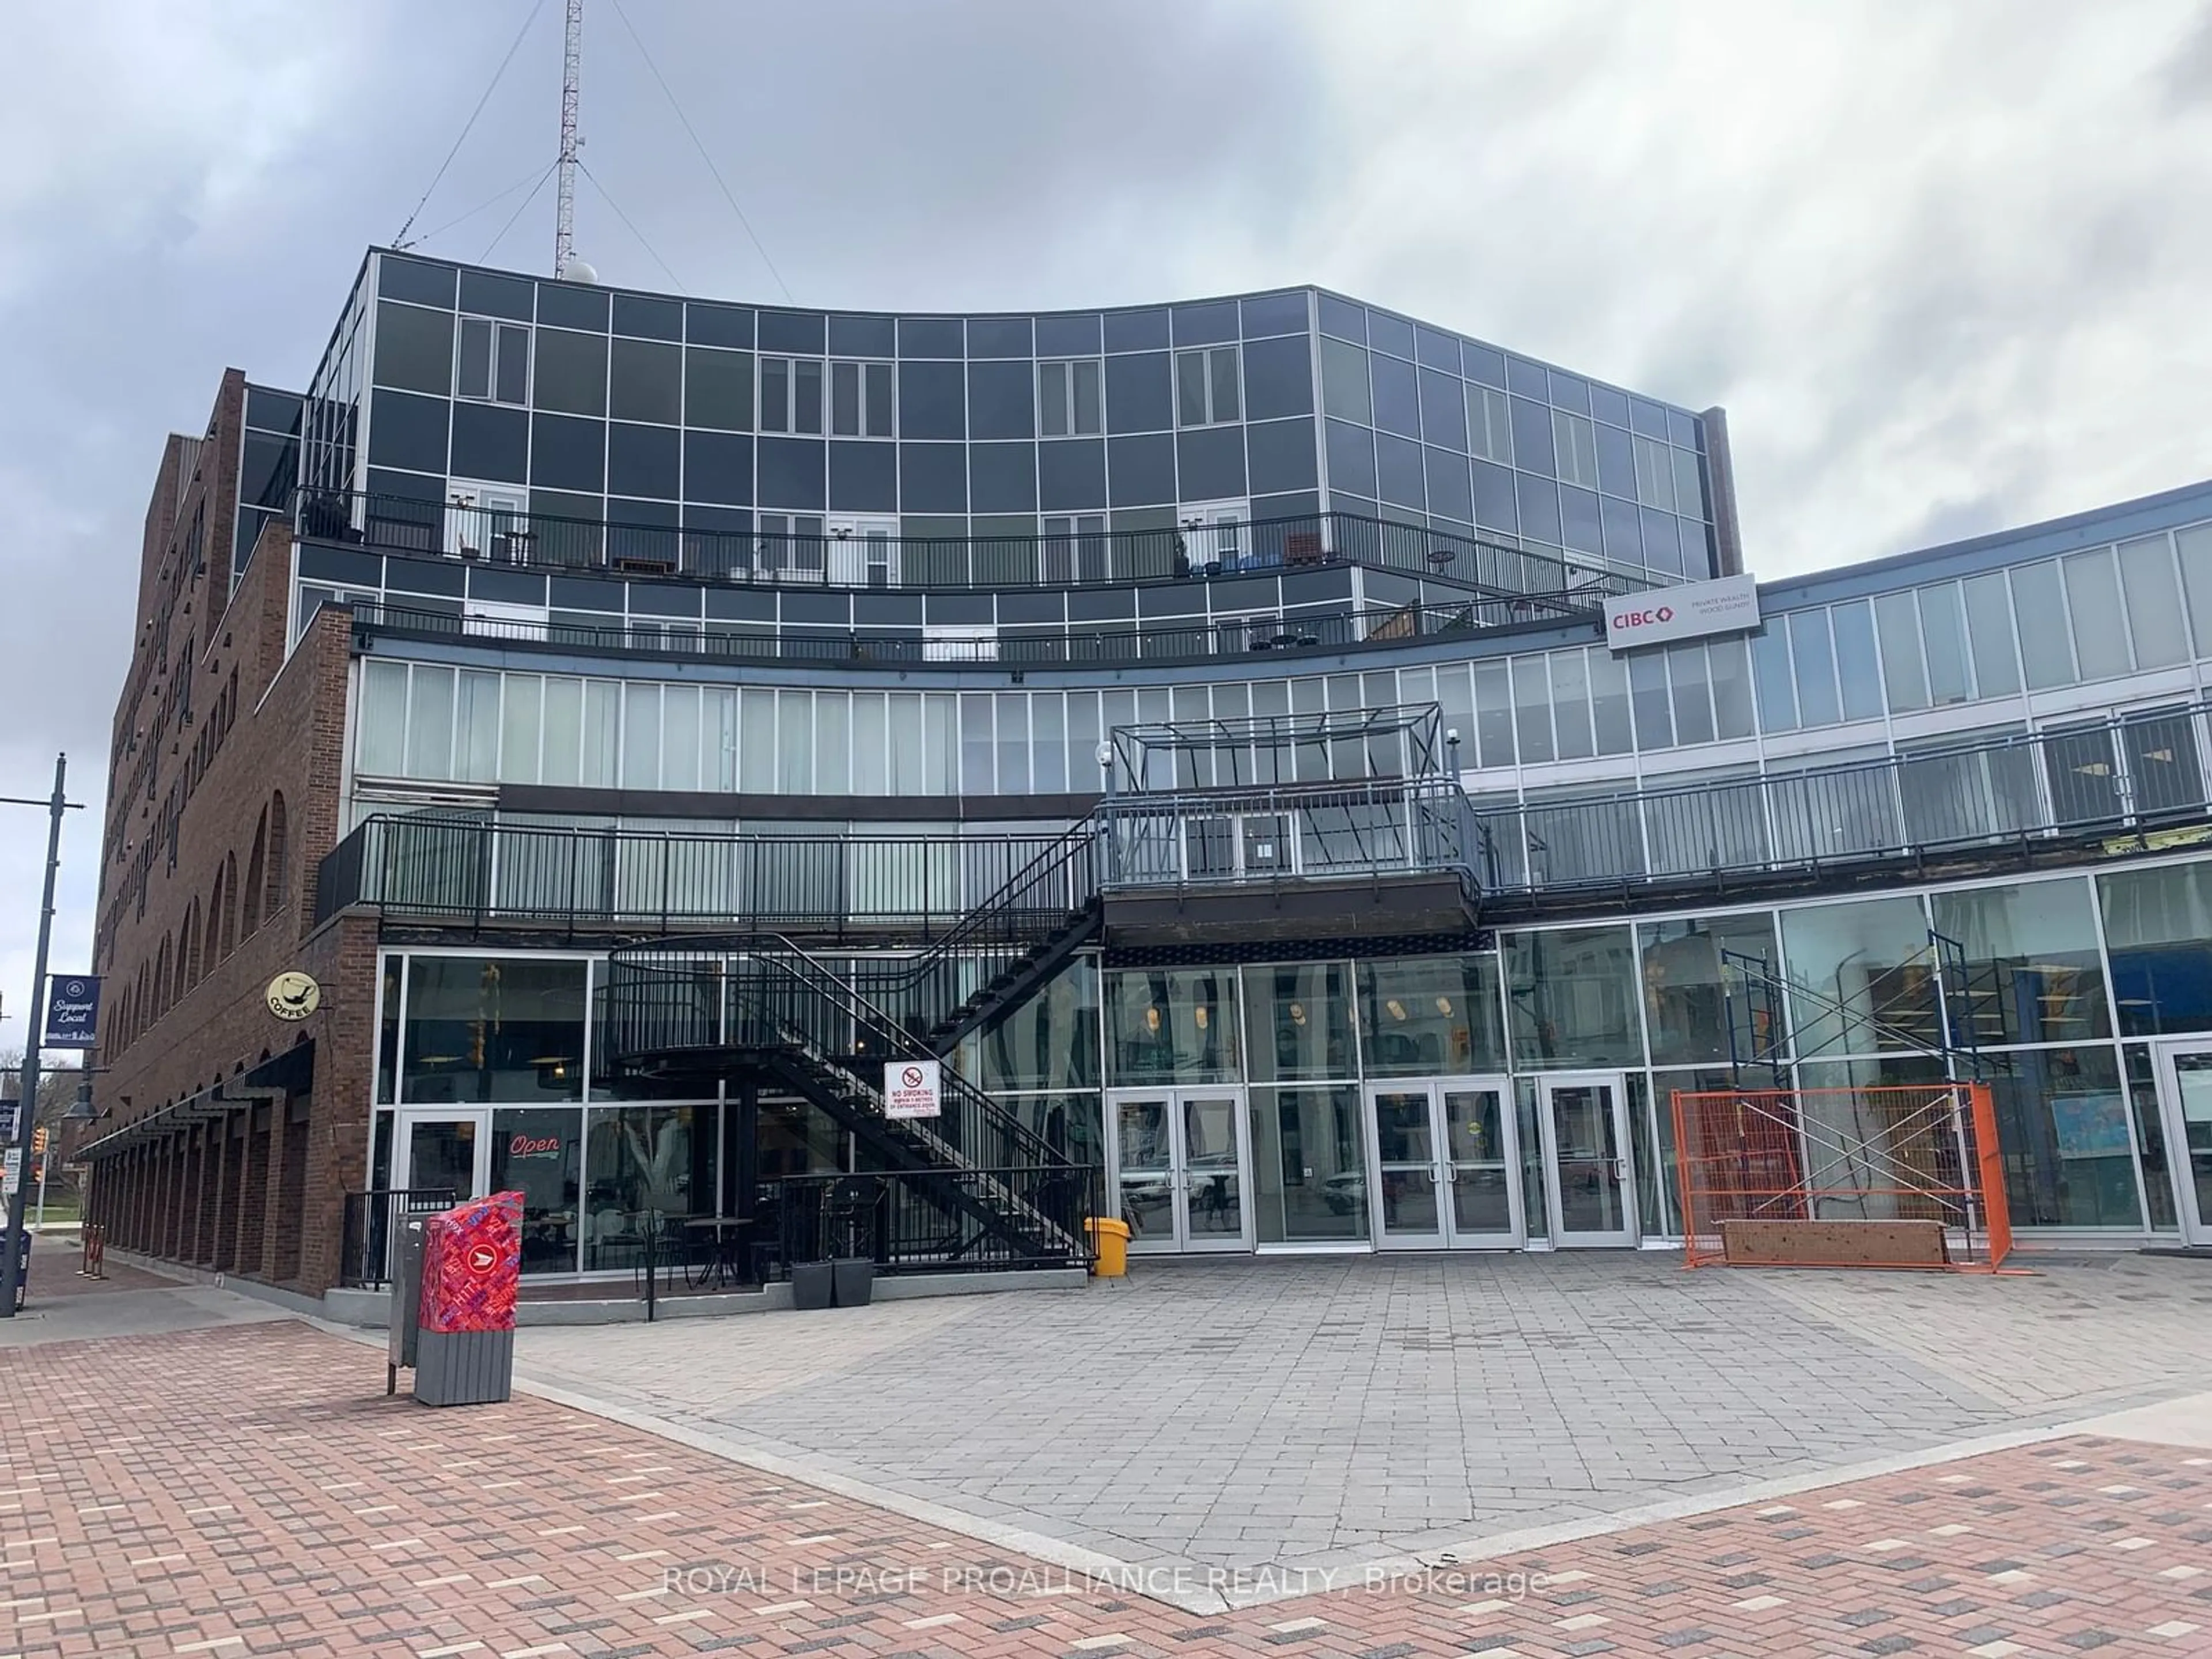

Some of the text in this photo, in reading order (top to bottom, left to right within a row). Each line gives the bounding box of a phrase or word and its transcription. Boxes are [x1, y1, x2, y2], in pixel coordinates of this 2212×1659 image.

[1691, 593, 1749, 608] PRIVATE WEALTH
[1613, 609, 1654, 629] CIBC
[54, 999, 93, 1014] Support
[270, 997, 311, 1017] COFFEE
[58, 1012, 86, 1024] Local
[903, 1089, 933, 1097] SMOKING
[510, 1135, 559, 1159] Open
